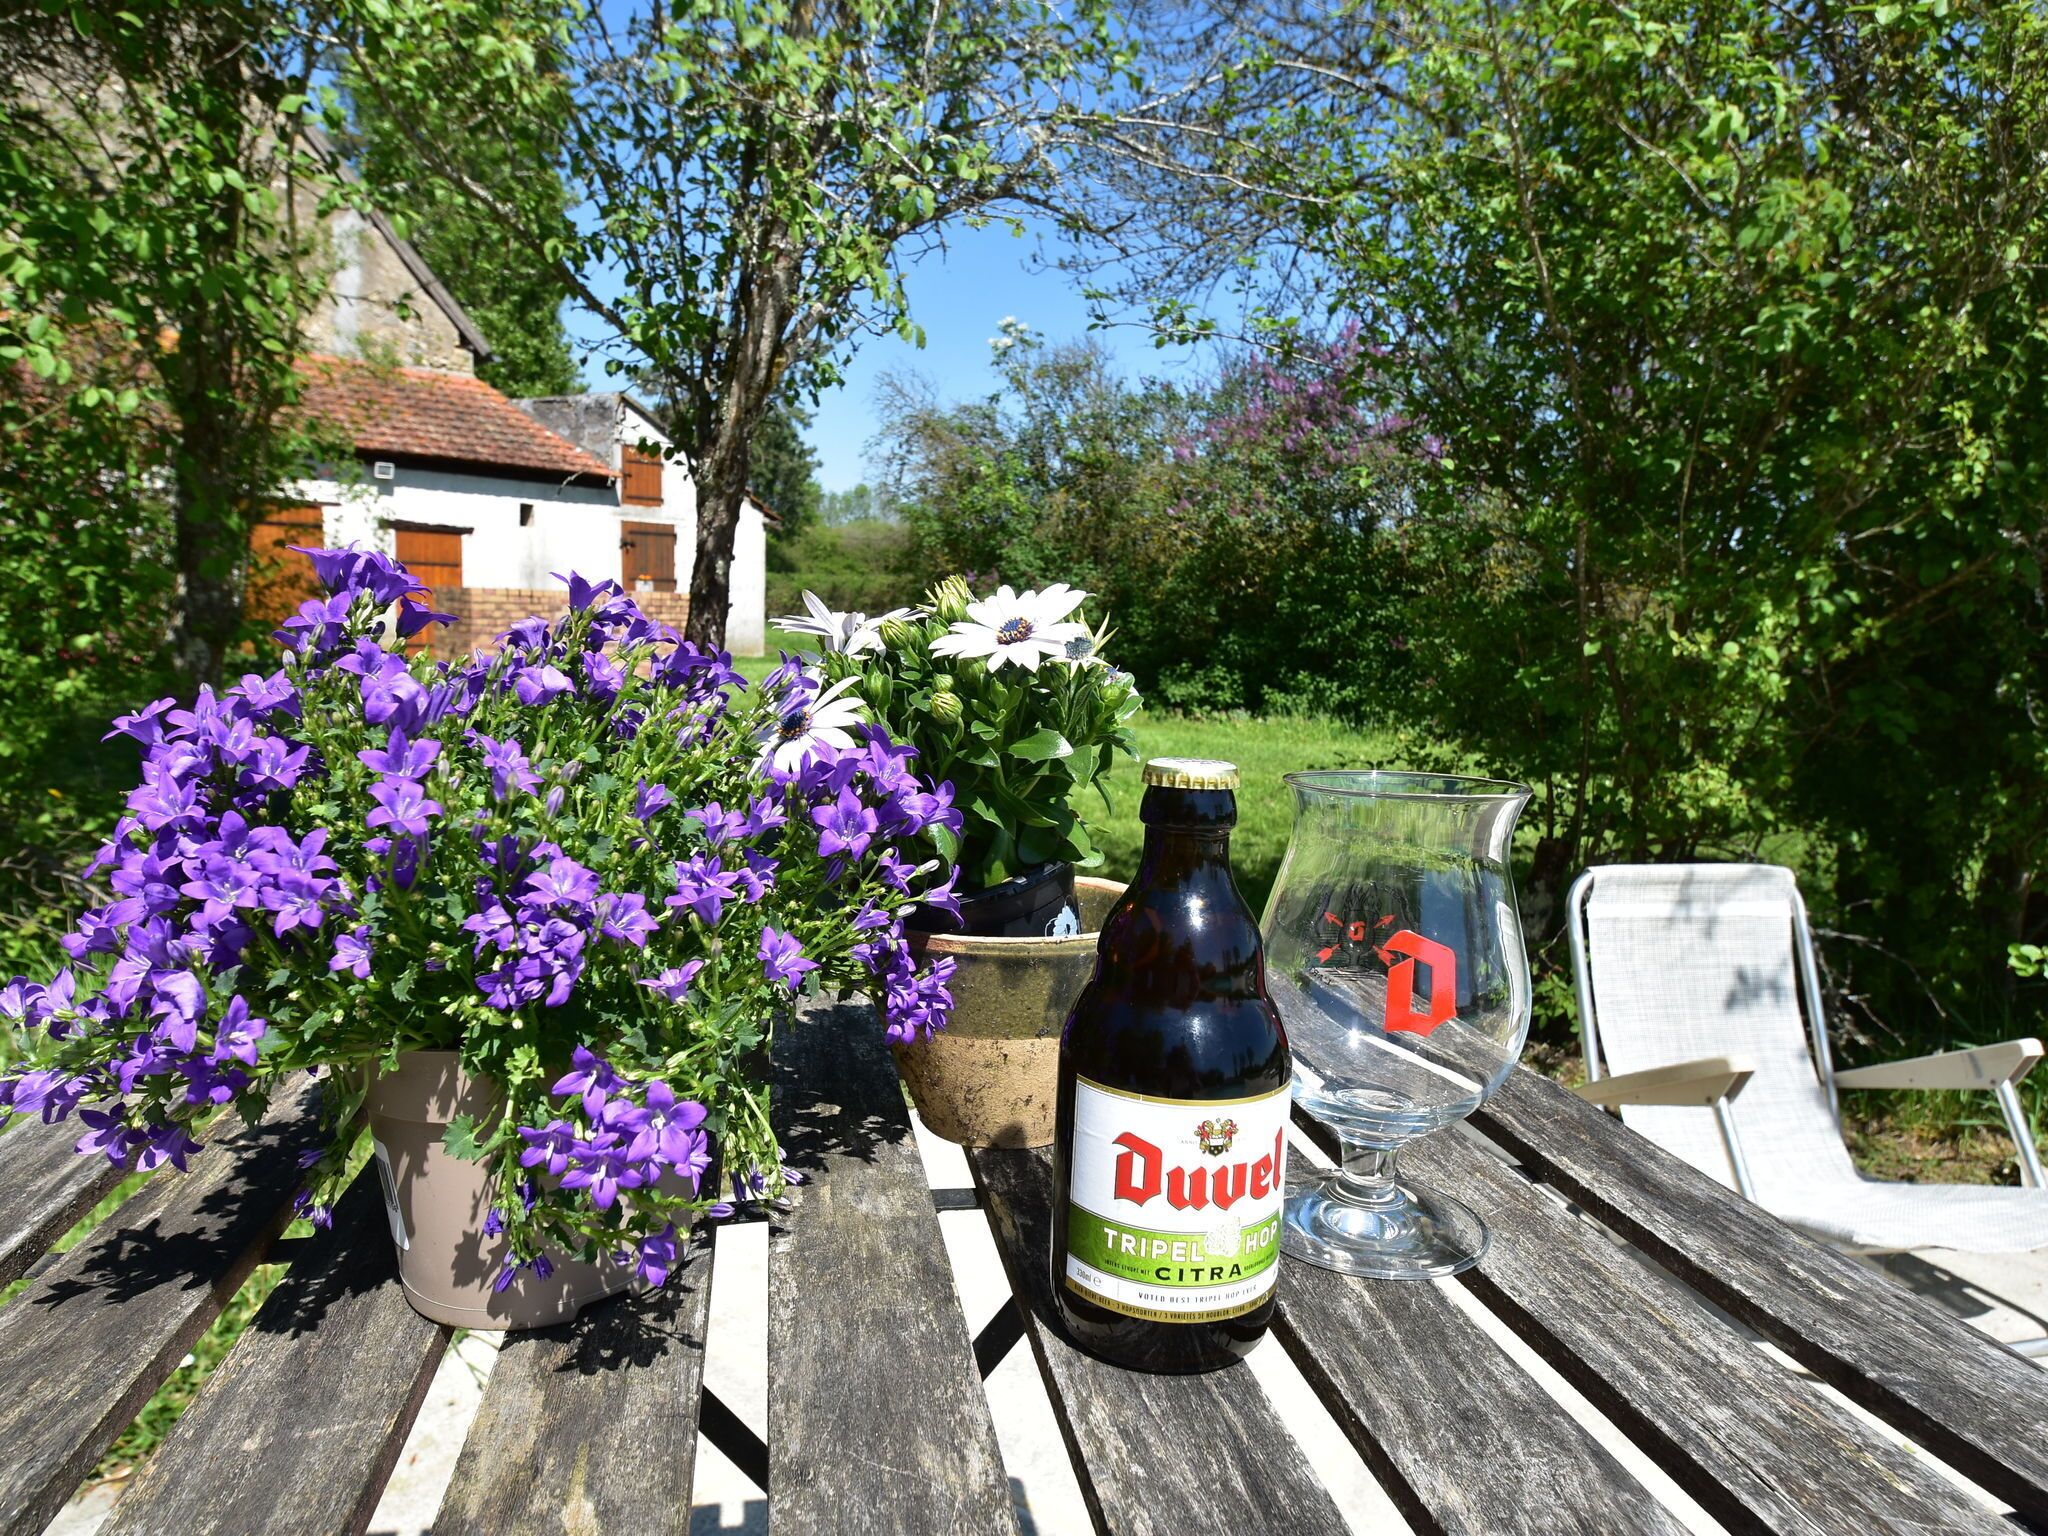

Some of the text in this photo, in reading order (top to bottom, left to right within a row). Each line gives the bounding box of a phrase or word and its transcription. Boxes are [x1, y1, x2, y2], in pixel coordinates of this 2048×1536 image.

[1383, 930, 1457, 1037] D
[1112, 1126, 1283, 1211] Duvel
[1103, 1220, 1278, 1262] TRIPEL HOP
[1154, 1263, 1242, 1282] CITRA
[1138, 1292, 1165, 1302] VOTED
[1169, 1296, 1190, 1304] BEST
[1195, 1294, 1221, 1303] TRIPEL
[1225, 1290, 1240, 1300] HOP
